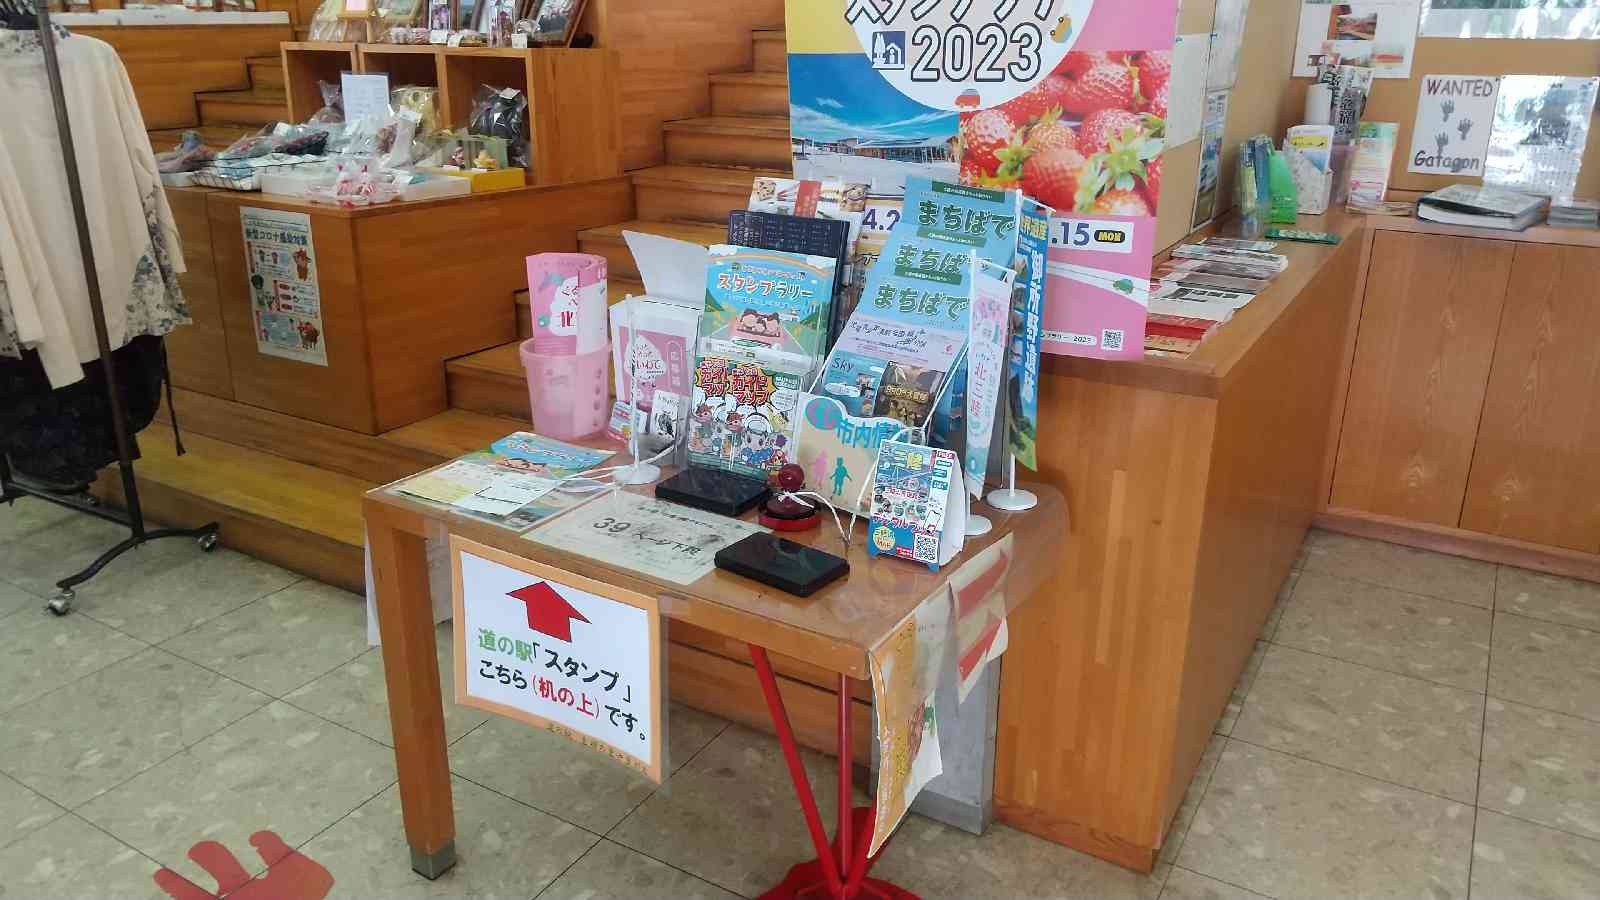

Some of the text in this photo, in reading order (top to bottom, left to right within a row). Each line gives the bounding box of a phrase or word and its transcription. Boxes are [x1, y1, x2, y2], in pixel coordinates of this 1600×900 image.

[911, 22, 1043, 83] 2023
[1426, 79, 1494, 97] WANTED
[1413, 150, 1480, 173] Gatagon
[1097, 230, 1122, 242] MON
[717, 272, 815, 299] スタンプラリー
[831, 356, 855, 375] Sky
